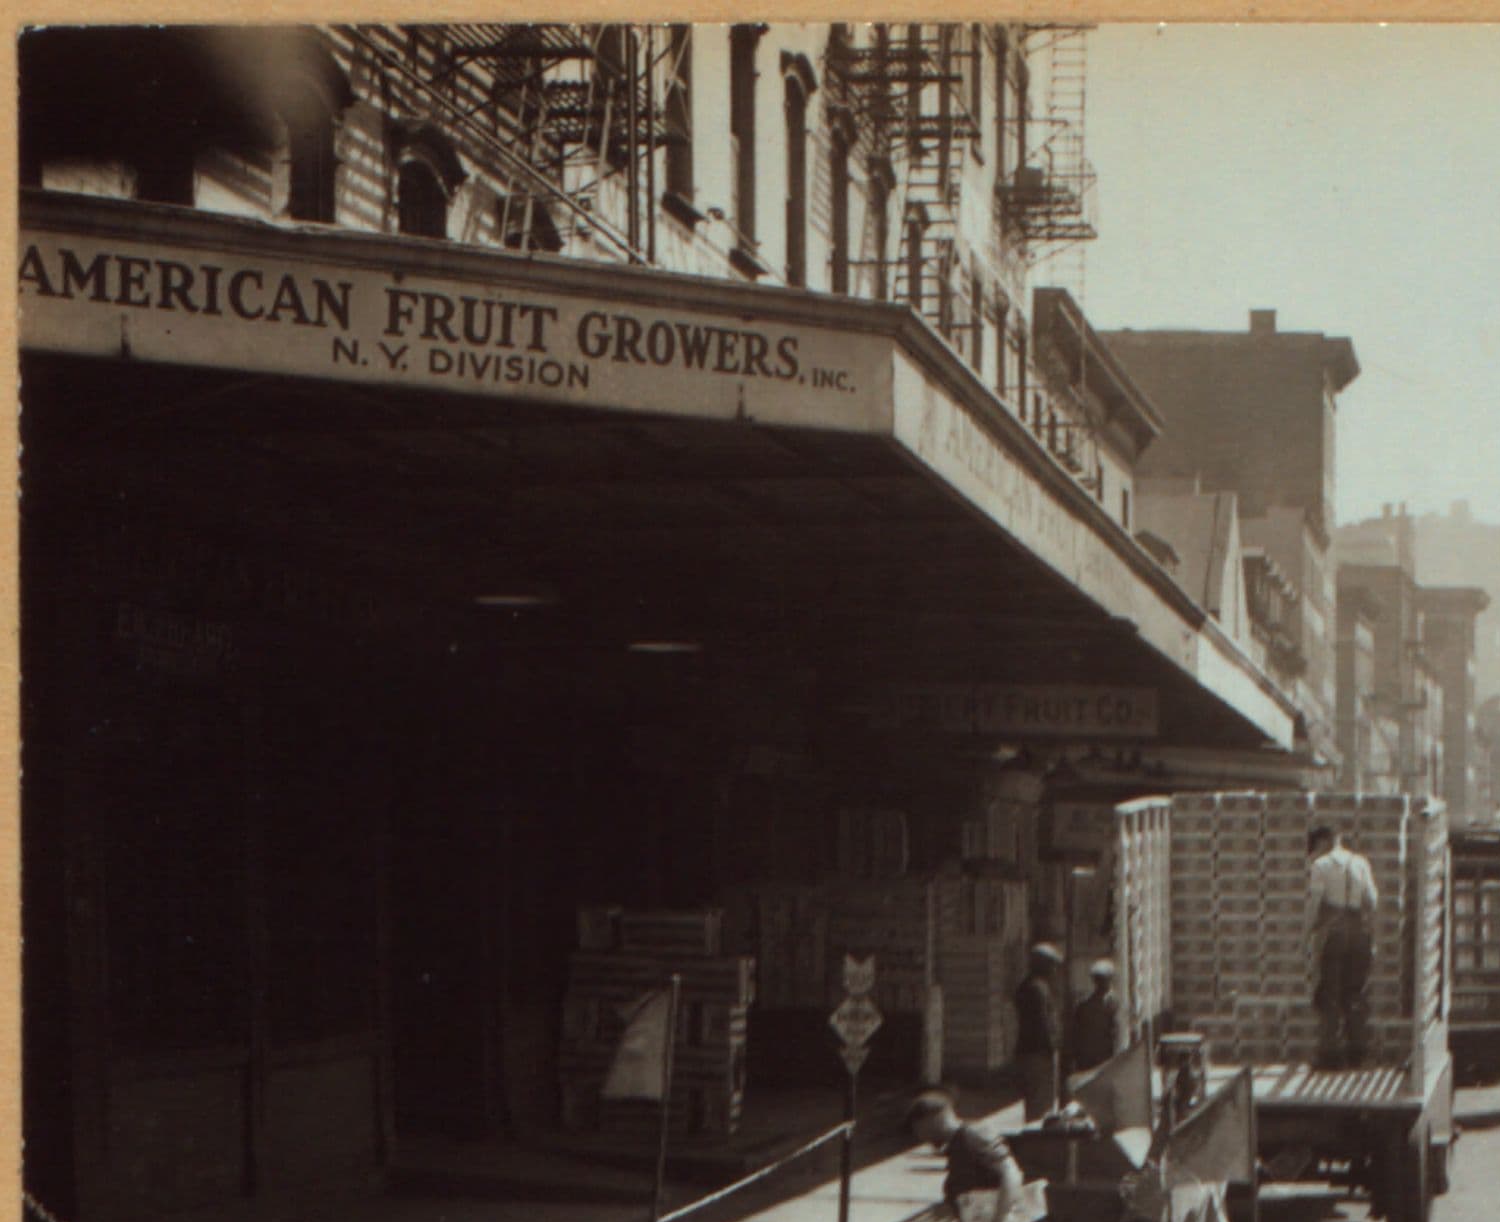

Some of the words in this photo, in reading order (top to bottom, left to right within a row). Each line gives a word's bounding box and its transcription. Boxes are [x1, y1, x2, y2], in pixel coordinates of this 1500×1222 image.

[19, 244, 353, 332] AMERICAN
[384, 285, 559, 353] FRUIT
[811, 367, 856, 394] INC.
[332, 335, 368, 367] N.
[378, 341, 409, 372] Y.
[428, 348, 590, 389] DIVISION
